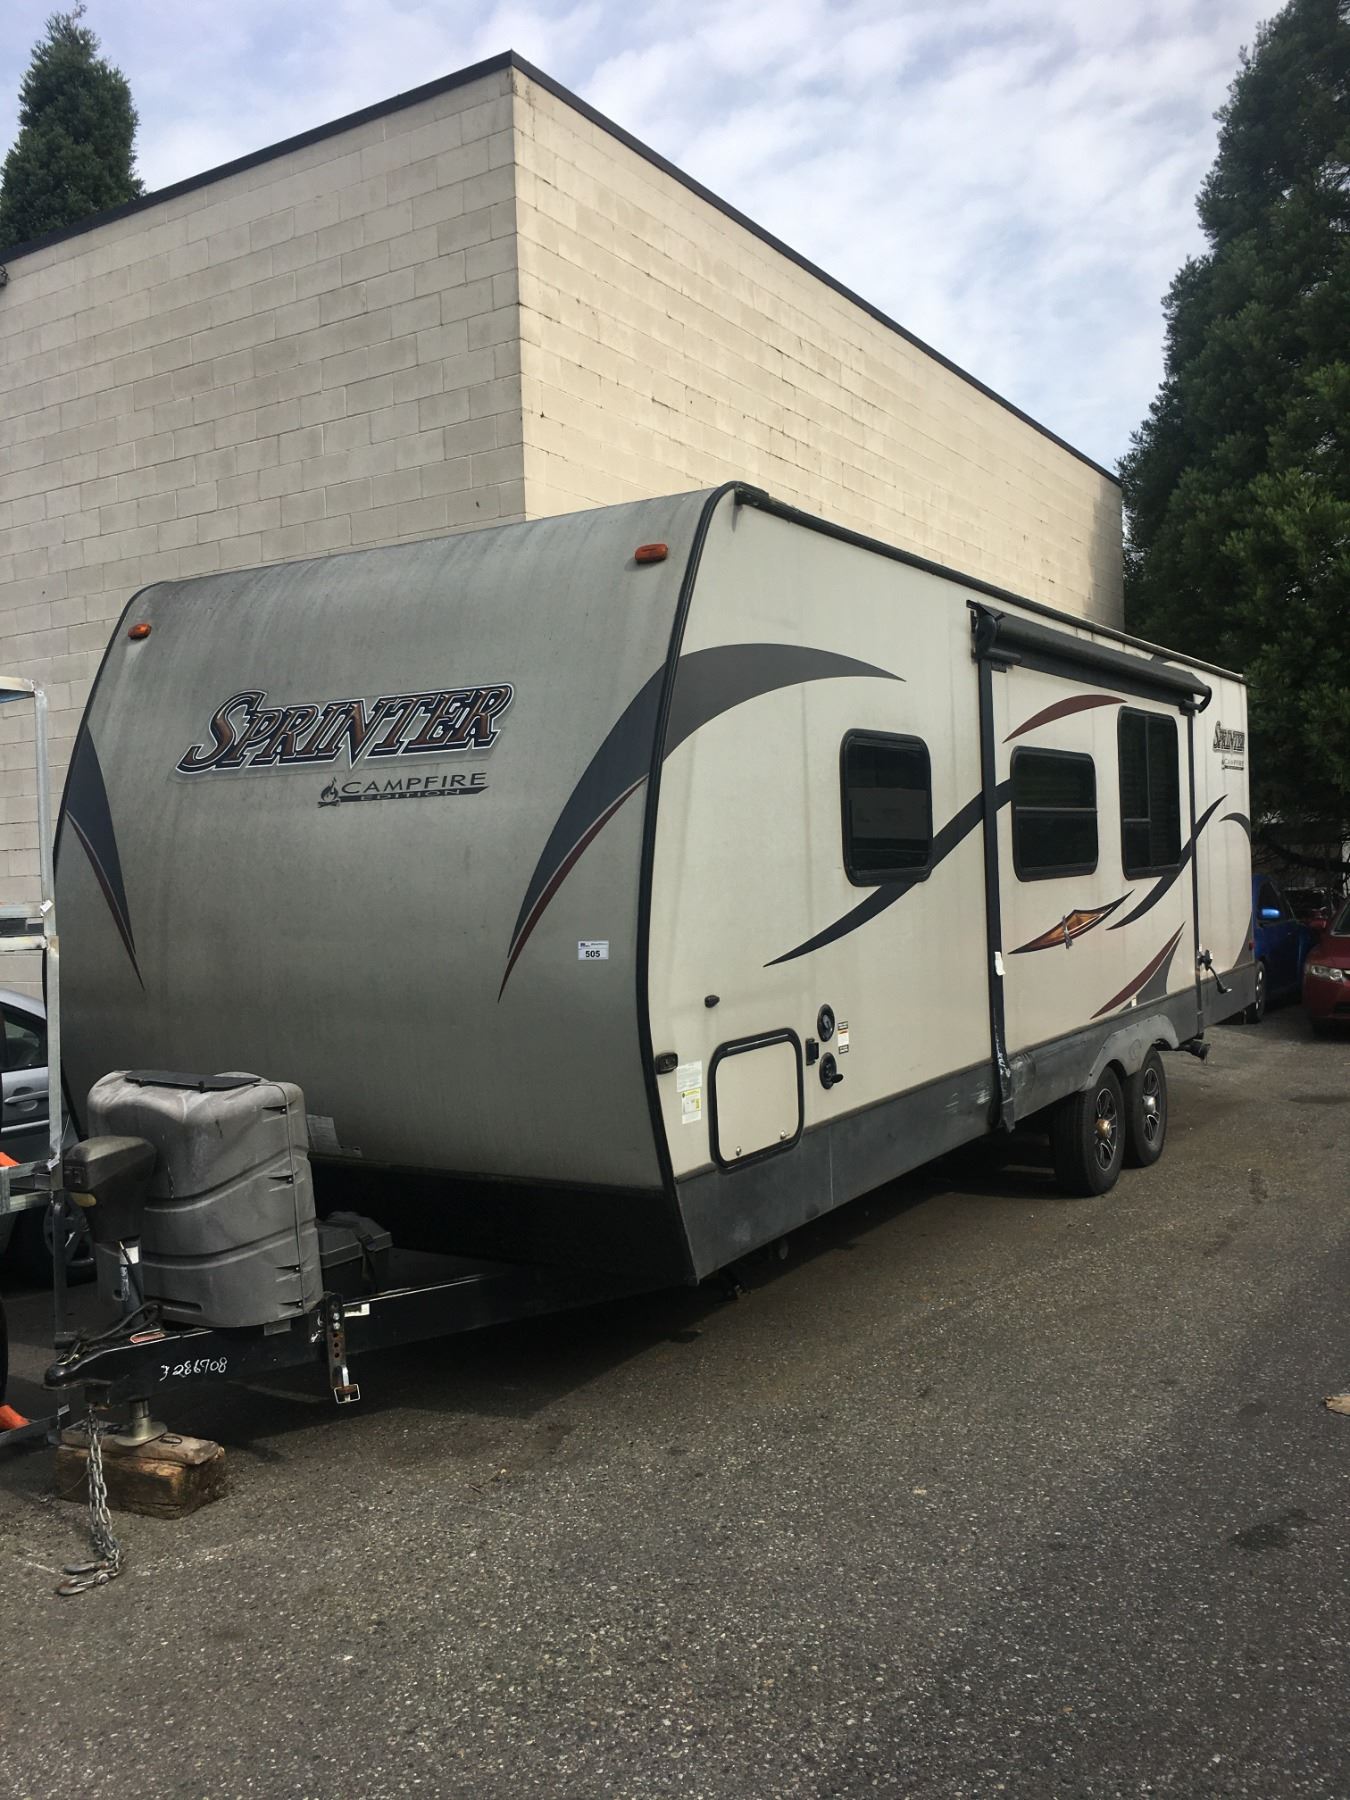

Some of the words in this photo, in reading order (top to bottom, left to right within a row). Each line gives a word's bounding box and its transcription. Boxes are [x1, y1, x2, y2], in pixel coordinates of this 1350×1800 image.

[341, 772, 488, 794] CAMPFIRE
[361, 789, 461, 801] EDITION
[585, 950, 601, 958] 505
